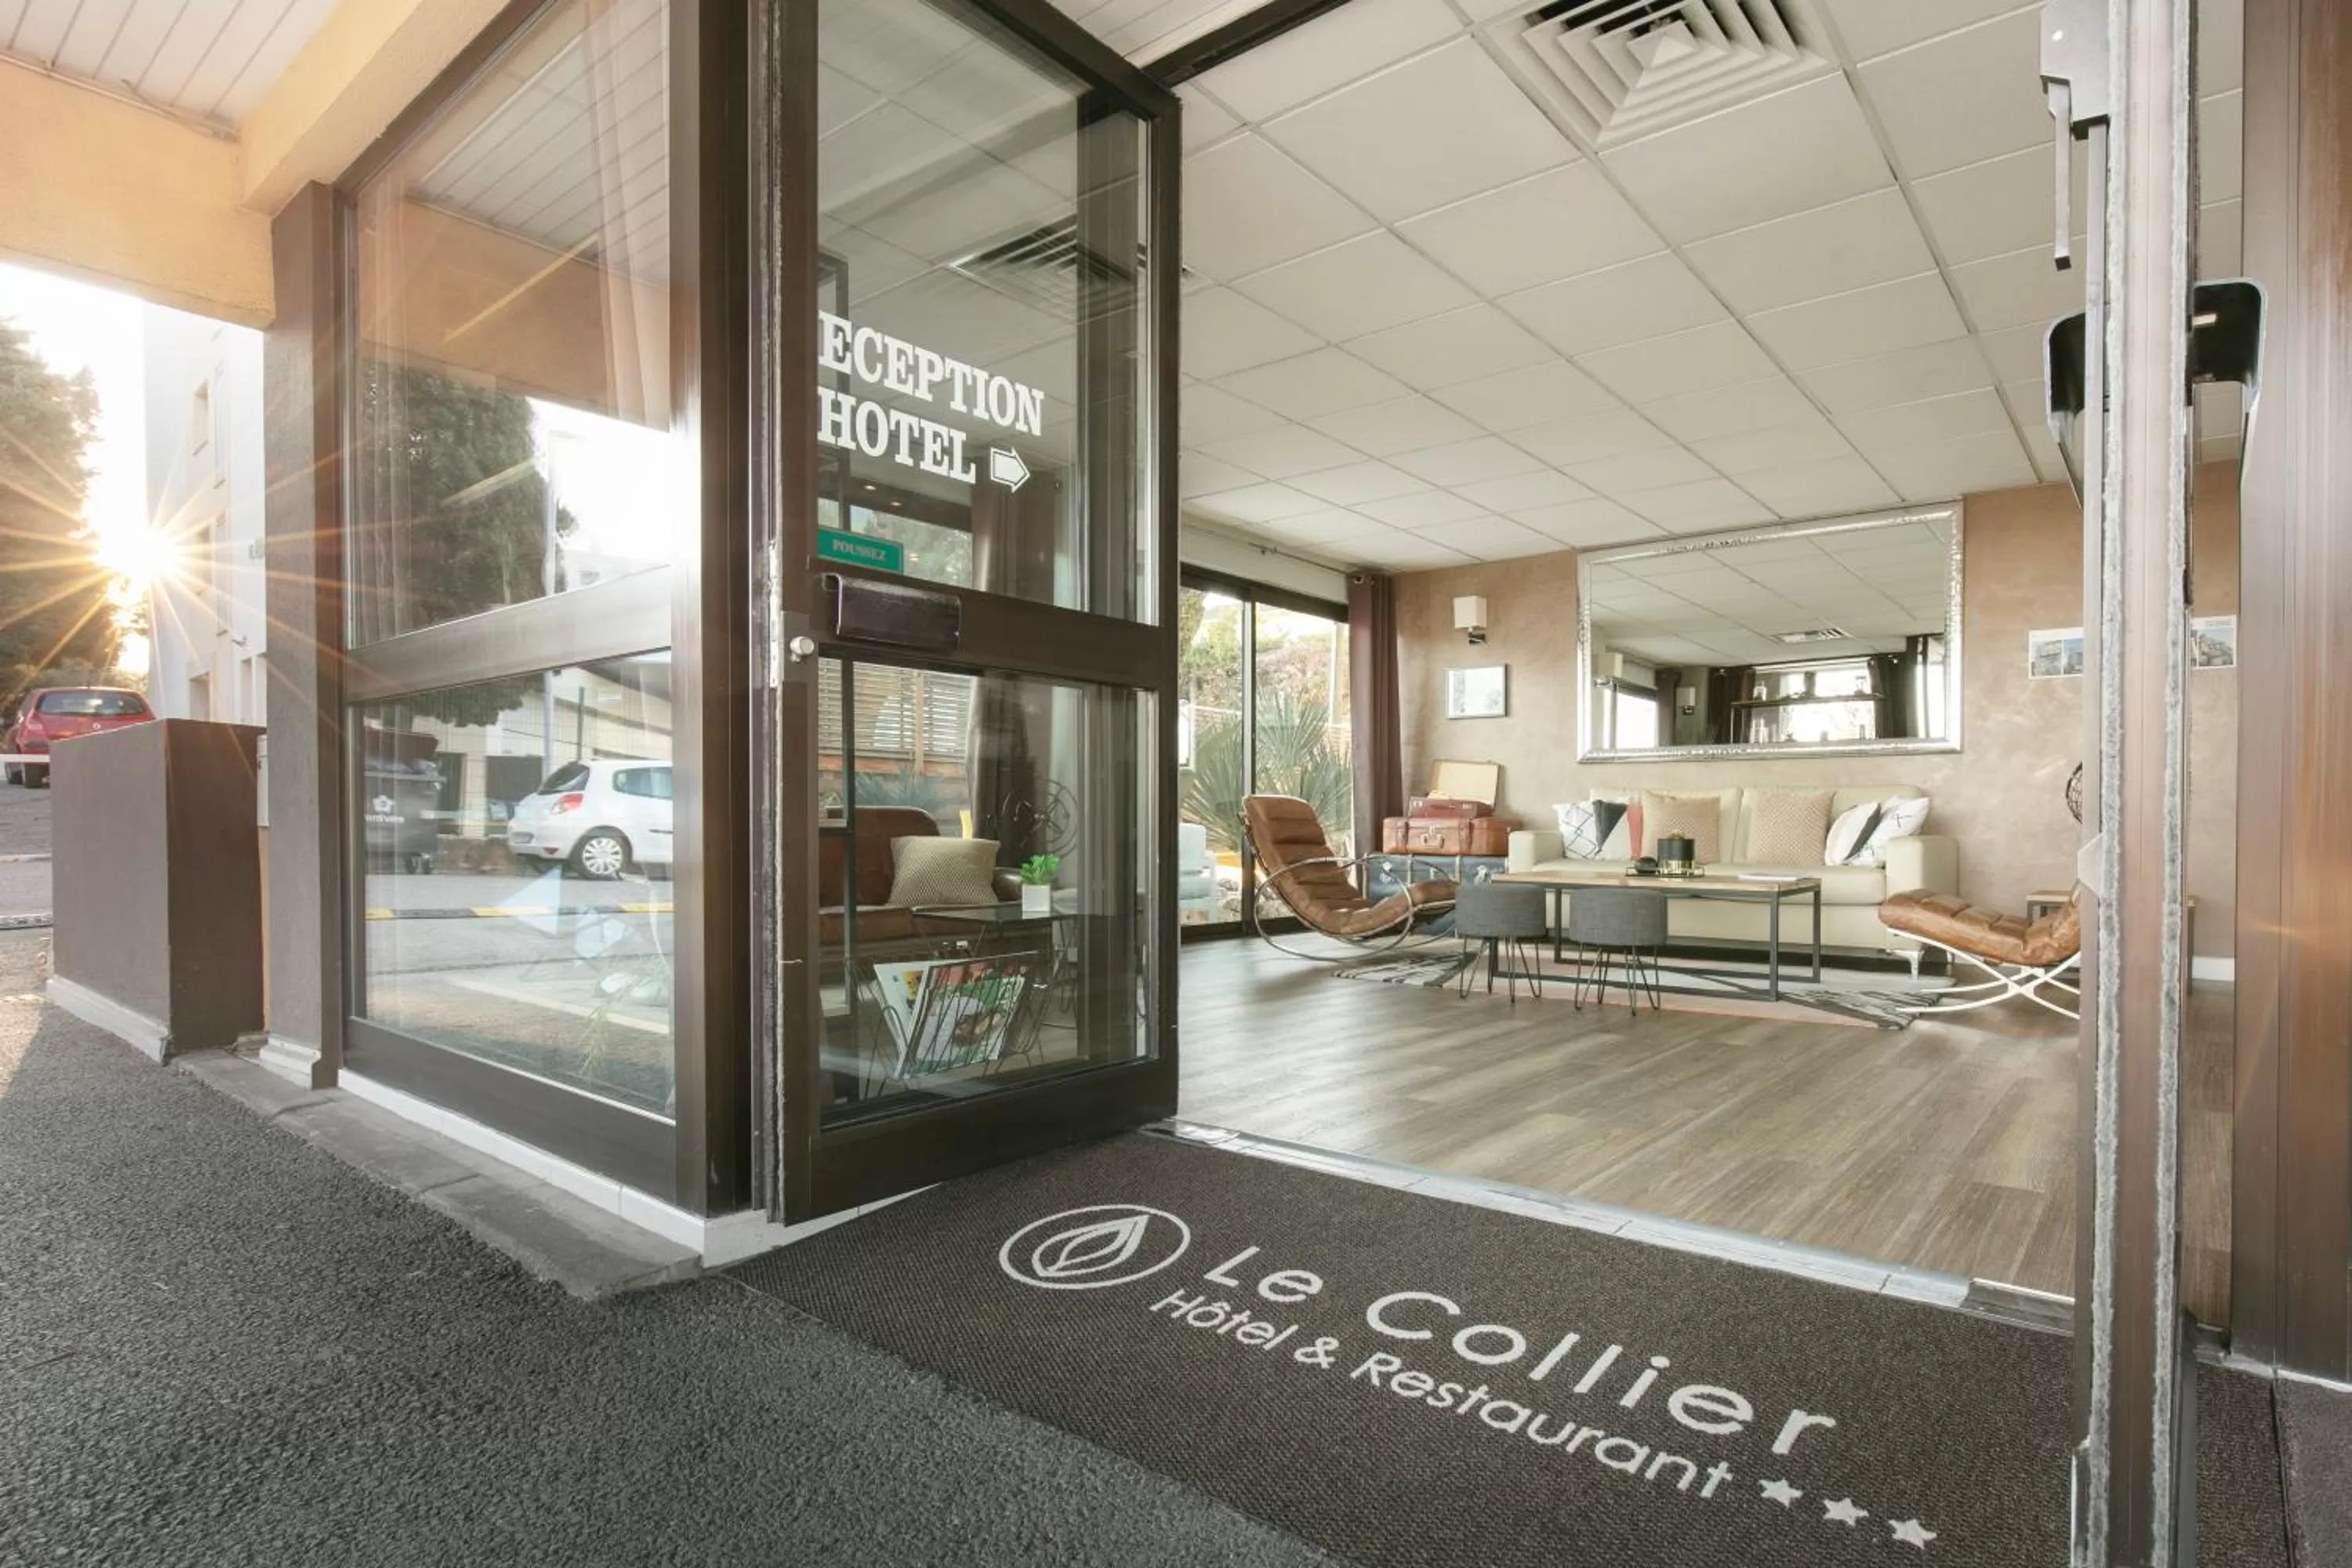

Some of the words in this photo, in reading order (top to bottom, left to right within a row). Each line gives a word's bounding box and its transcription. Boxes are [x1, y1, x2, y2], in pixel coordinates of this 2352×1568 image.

[817, 386, 975, 484] HOTEL
[818, 310, 1044, 435] ECEPTION
[1149, 1289, 1298, 1350] Hôtel
[1294, 1337, 1338, 1368] &
[1350, 1352, 1732, 1497] Restaurant
[1203, 1246, 1323, 1302] Le
[1367, 1291, 1835, 1454] Collier
